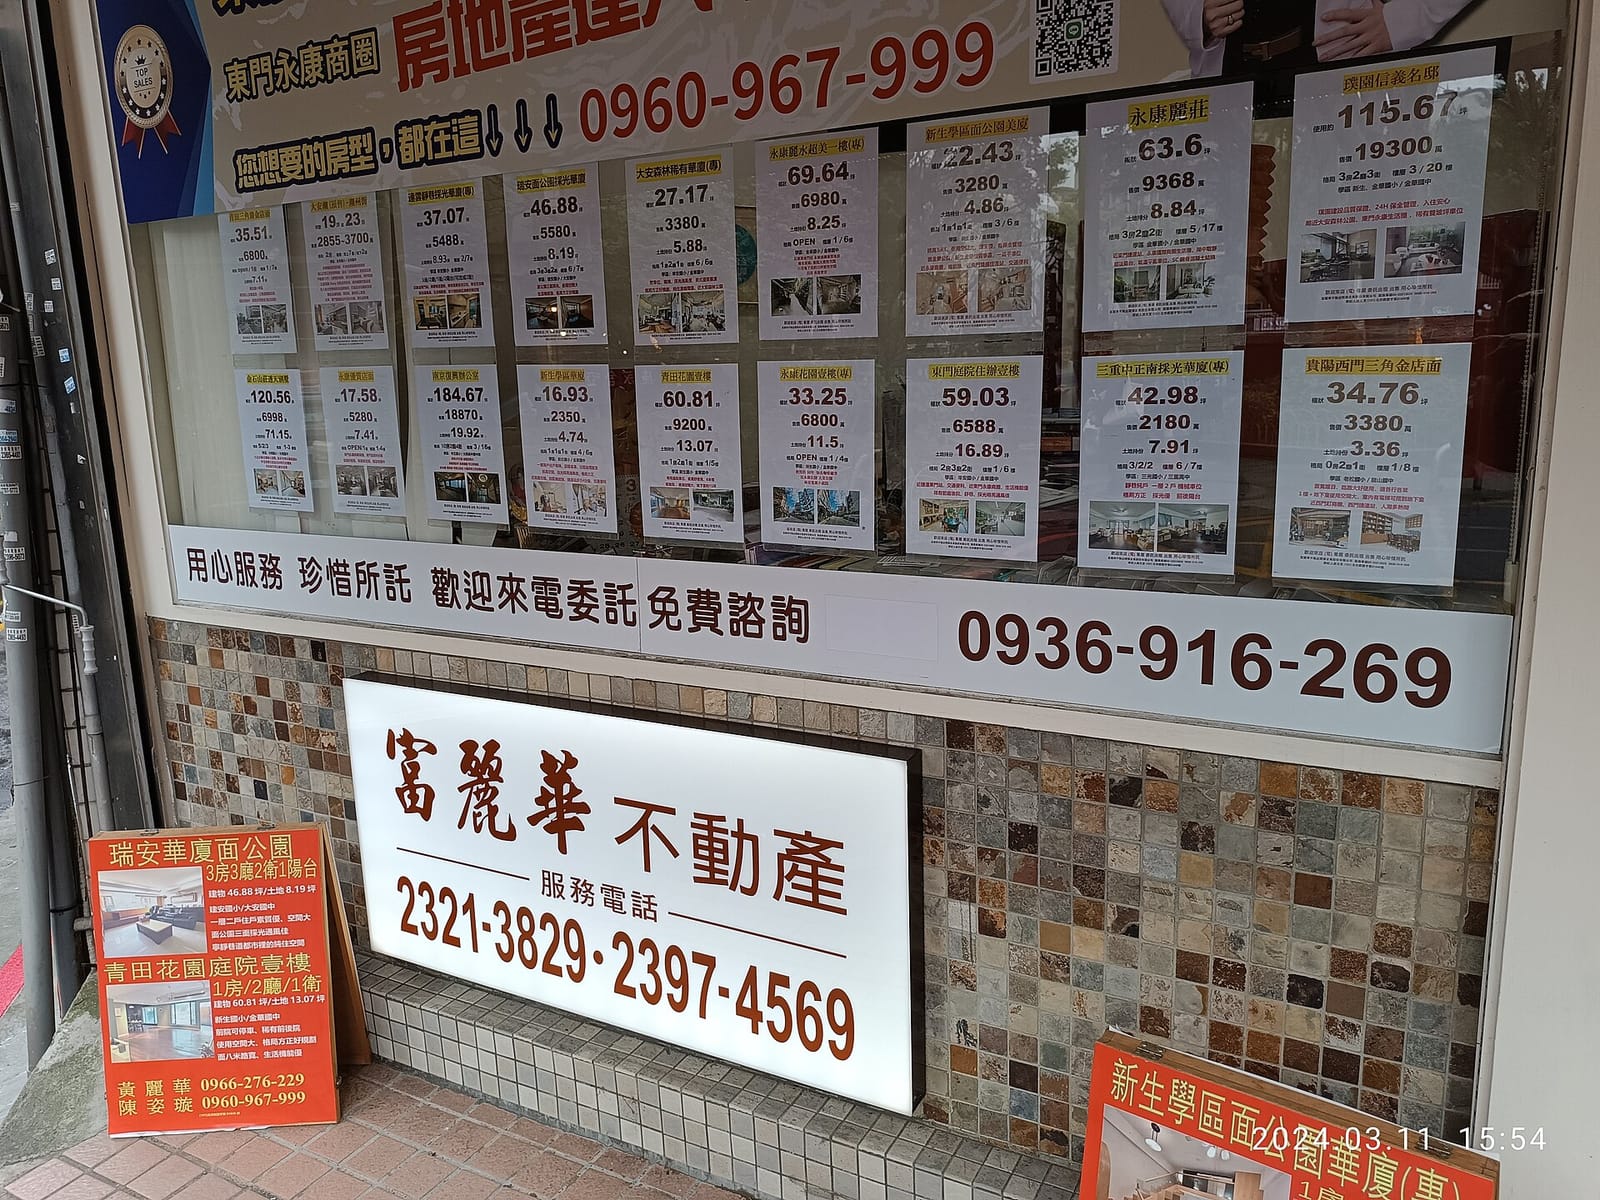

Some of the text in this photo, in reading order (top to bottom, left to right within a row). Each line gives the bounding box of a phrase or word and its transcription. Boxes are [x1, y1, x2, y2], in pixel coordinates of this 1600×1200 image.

[136, 68, 148, 77] TOP
[225, 30, 380, 101] 東門永康商圈
[134, 77, 152, 88] SALES
[580, 21, 994, 142] 0960-967-999
[1343, 65, 1440, 92] 璞園信義名邸
[1129, 98, 1209, 126] 永康麗莊
[1338, 91, 1458, 129] 115.67
[1138, 134, 1203, 160] 63.6
[1355, 136, 1433, 160] 19300
[788, 161, 849, 186] 69.64
[1142, 172, 1195, 191] 9368
[954, 175, 999, 193] 3280
[655, 184, 708, 207] 27.17
[801, 191, 840, 207] 6980
[531, 197, 578, 216] 46.88
[964, 198, 1004, 214] 4.86
[1150, 200, 1197, 219] 8.84
[423, 207, 465, 226] 37.07
[665, 216, 699, 231] 3380
[807, 215, 841, 230] 8.25
[235, 226, 268, 242] 35.51
[317, 233, 369, 247] 2855-3700
[540, 225, 571, 239] 5580
[432, 234, 459, 247] 5488
[673, 239, 702, 253] 5.88
[793, 238, 816, 246] OPEN
[243, 250, 265, 261] 6800
[548, 247, 574, 260] 8.19
[1097, 359, 1229, 376] 三重中正南採光華廈(專)
[1306, 357, 1443, 373] 貴陽西門三角金店面
[251, 390, 291, 403] 120.56
[341, 389, 377, 402] 17.58
[434, 387, 483, 402] 184.67
[543, 387, 588, 402] 16.93
[663, 390, 713, 408] 60.81
[789, 388, 846, 405] 33.25
[942, 387, 1009, 406] 59.03
[1128, 386, 1198, 405] 42.98
[1326, 382, 1420, 404] 34.76
[262, 412, 283, 422] 6998
[349, 412, 373, 422] 5280
[445, 409, 478, 420] 18870
[551, 411, 580, 423] 2350
[801, 414, 838, 427] 6800
[1139, 415, 1190, 429] 2180
[673, 418, 706, 431] 9200
[953, 419, 995, 432] 6588
[1344, 415, 1403, 432] 3380
[265, 429, 289, 439] 71.15
[355, 430, 375, 440] 7.41
[450, 427, 479, 438] 19.92
[558, 431, 584, 442] 4.74
[677, 440, 713, 452] 13.07
[807, 436, 838, 448] 11.5
[955, 443, 1003, 457] 16.89
[1149, 440, 1189, 454] 7.91
[1350, 440, 1400, 457] 3.36
[186, 548, 1452, 708] 用心服務 珍惜所託 歡迎來電委託 免費諮詢 0936-916-269
[386, 727, 848, 916] 富麗華 不動產
[109, 834, 292, 867] 瑞安華廈面公園
[206, 858, 317, 882] 3房3廳2衛1陽台
[227, 888, 253, 896] 46.88
[540, 869, 659, 923] 服務電話
[104, 952, 311, 982] 青田花園庭院壹樓
[397, 876, 855, 1061] 2321-3829 2397-4569
[213, 974, 322, 997] 1房/2廳/1衛
[233, 998, 256, 1007] 60.81
[201, 1073, 305, 1091] 0966-276-229
[202, 1091, 306, 1109] 0960-967-999
